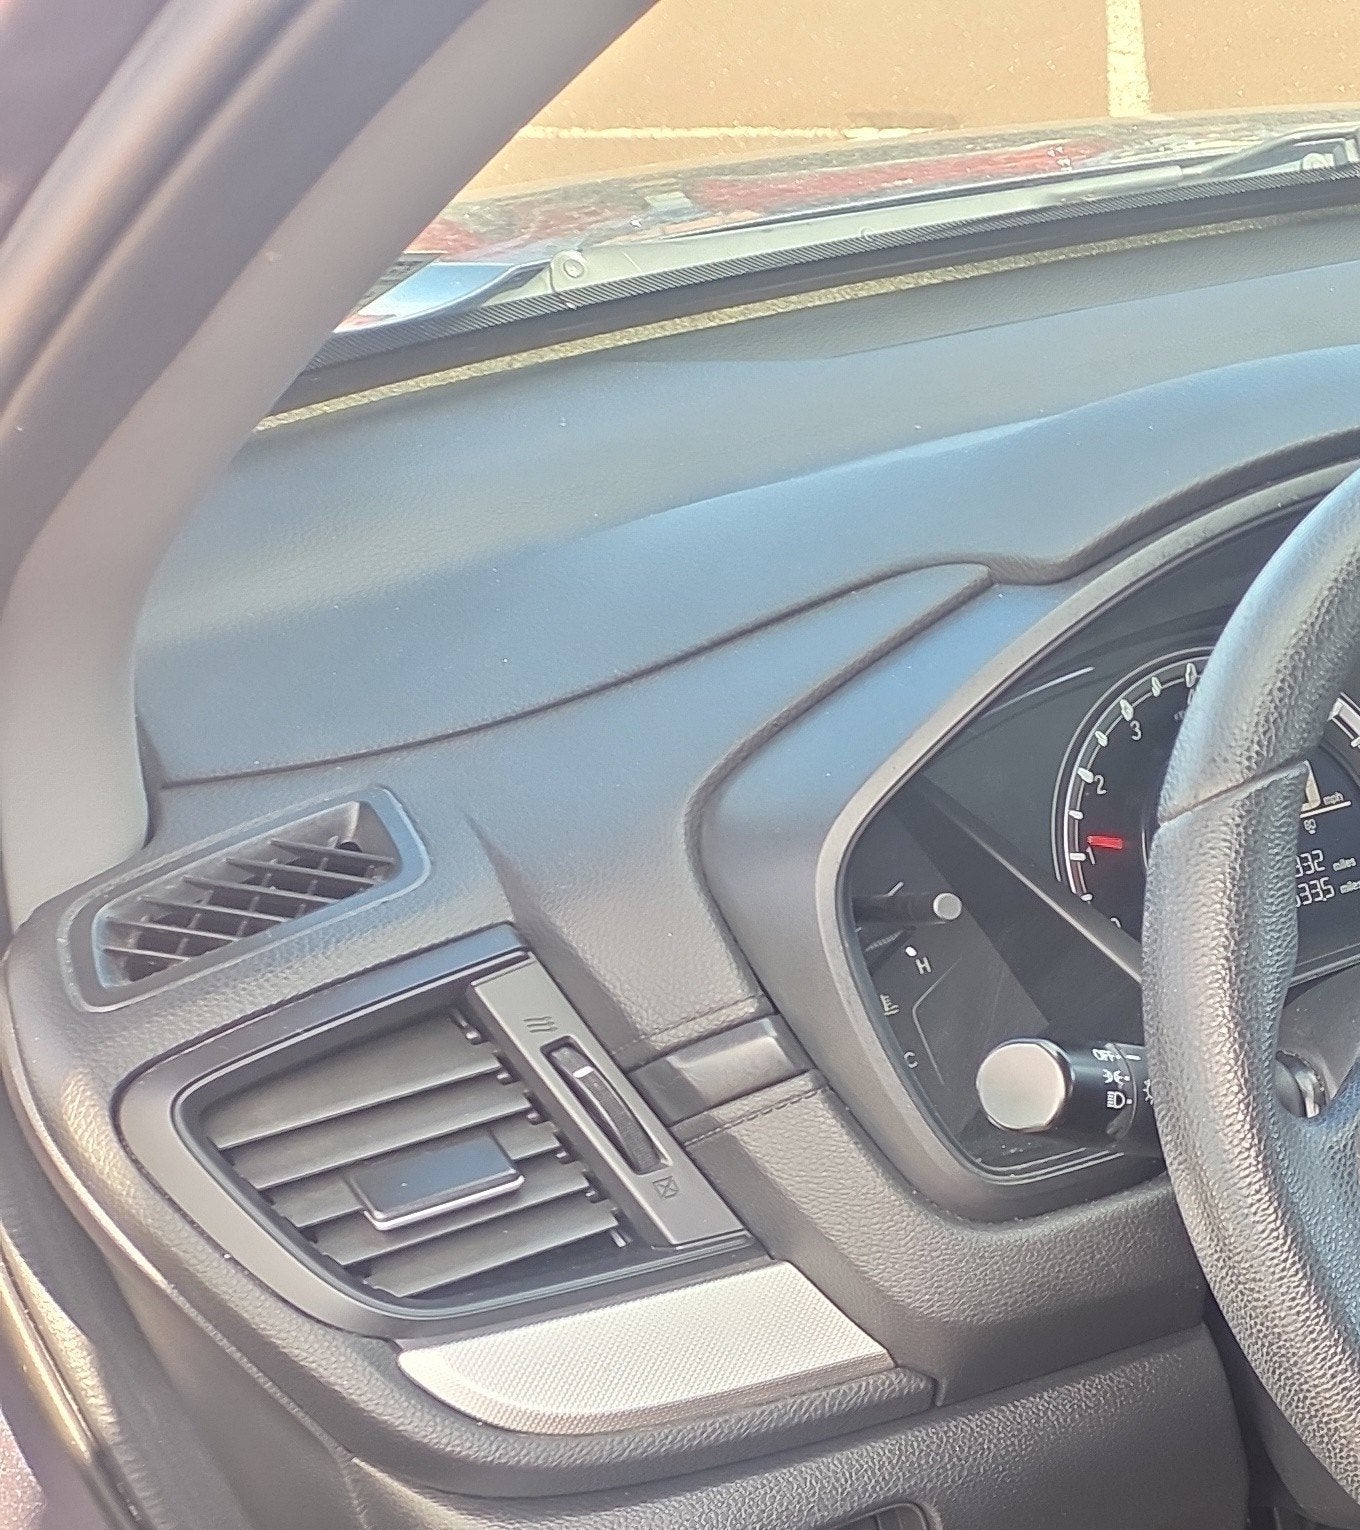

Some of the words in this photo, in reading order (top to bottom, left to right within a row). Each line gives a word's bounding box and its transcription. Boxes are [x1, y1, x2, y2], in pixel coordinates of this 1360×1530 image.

[1130, 720, 1142, 741] 3
[1094, 774, 1107, 795] 2
[915, 956, 932, 975] H
[903, 1051, 918, 1069] C
